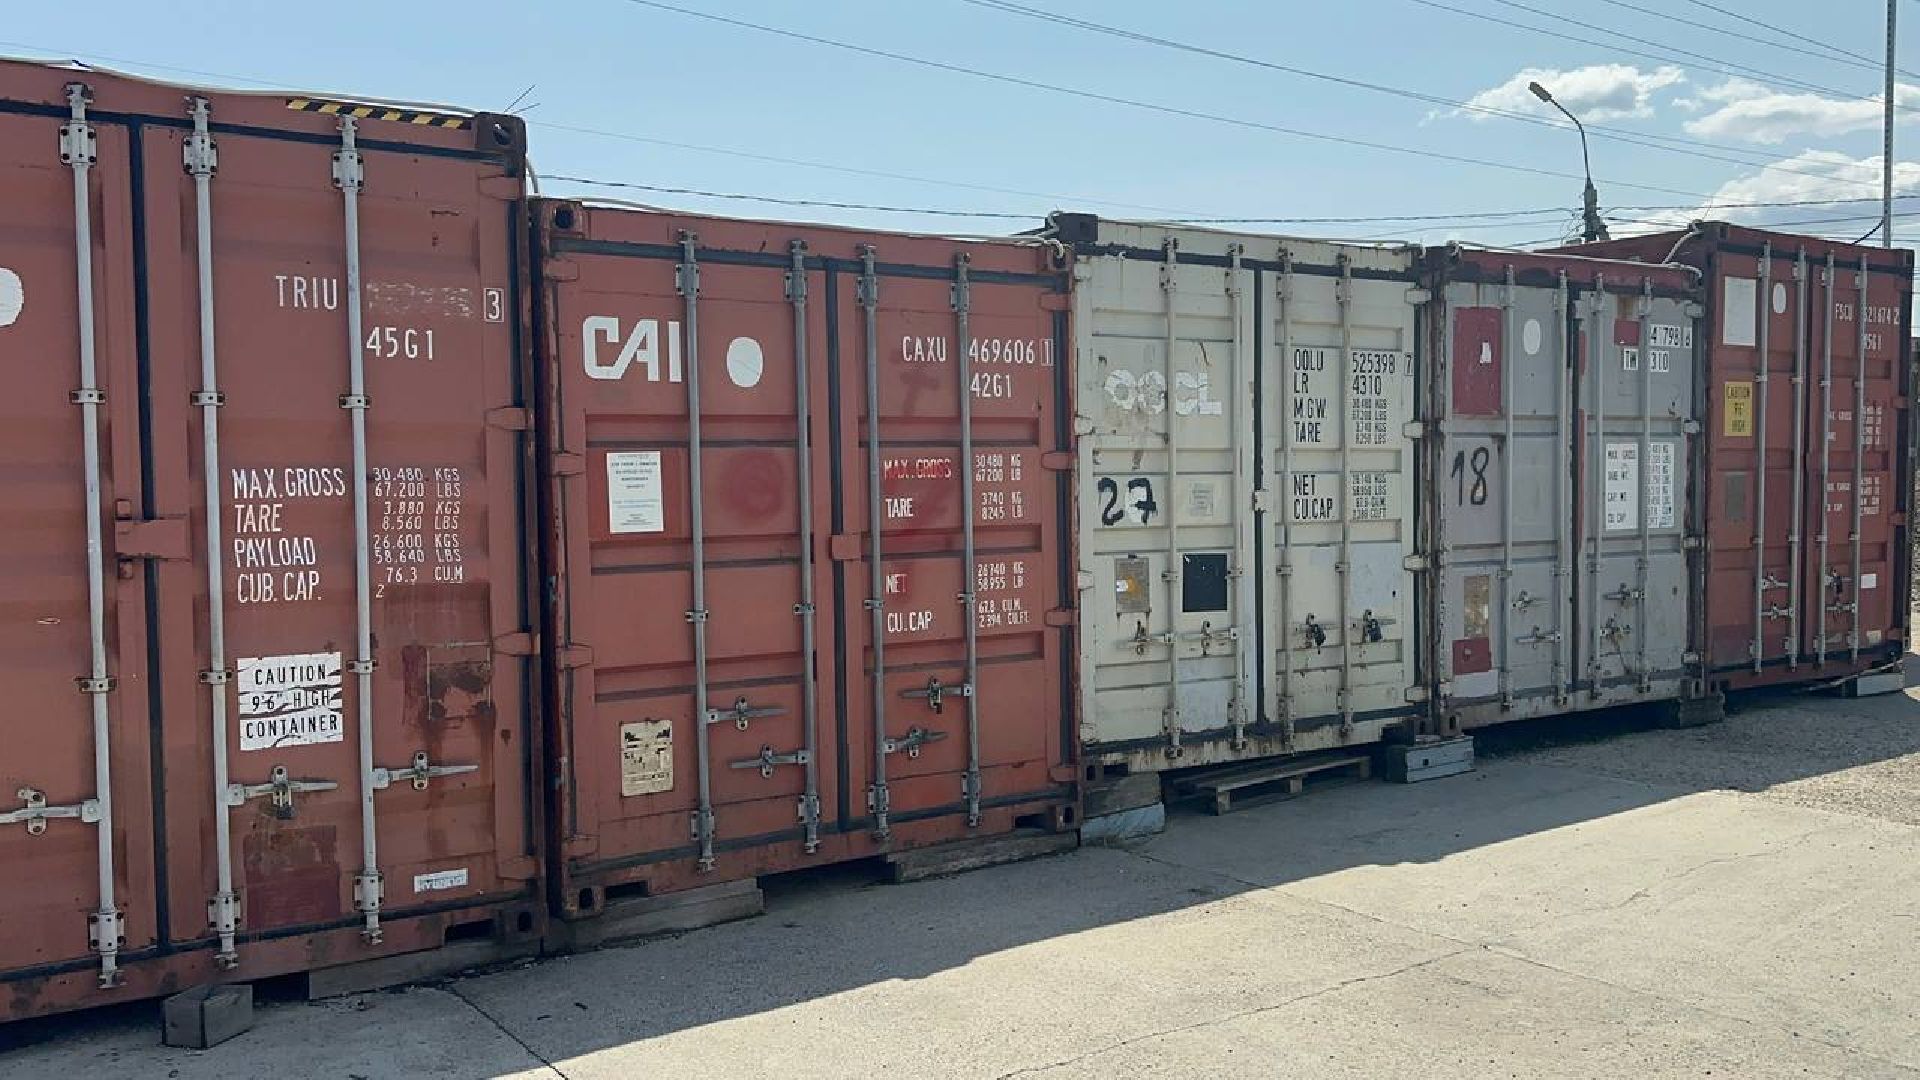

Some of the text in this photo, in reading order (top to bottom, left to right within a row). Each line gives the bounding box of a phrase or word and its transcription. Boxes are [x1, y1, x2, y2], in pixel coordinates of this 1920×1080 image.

[276, 275, 338, 310] TRIU
[485, 289, 502, 321] 3
[366, 327, 433, 360] 45G1
[583, 316, 682, 383] CAI
[902, 336, 947, 362] CAXU
[969, 338, 1035, 364] 469606
[1293, 349, 1412, 375] OOLU 525398 7
[970, 373, 1012, 398] 42G1
[1293, 372, 1382, 396] LR 4310
[1293, 422, 1321, 443] TARE
[434, 467, 460, 481] KGS
[1293, 474, 1316, 496] NET
[1451, 447, 1490, 506] 18
[375, 482, 461, 498] 67.200 LBS
[1098, 477, 1157, 526] 27
[234, 504, 282, 533] TARE
[435, 501, 460, 515] KGS
[886, 498, 913, 518] TARE
[434, 515, 458, 530] LBS
[234, 537, 316, 568] PAYLOAD
[434, 533, 460, 548] KGS
[435, 549, 461, 563] LBS
[386, 566, 418, 583] 76.3
[886, 574, 907, 594] NET
[255, 664, 326, 686] CAUTION
[293, 690, 330, 709] HIGH
[246, 714, 338, 739] CONTAINER
